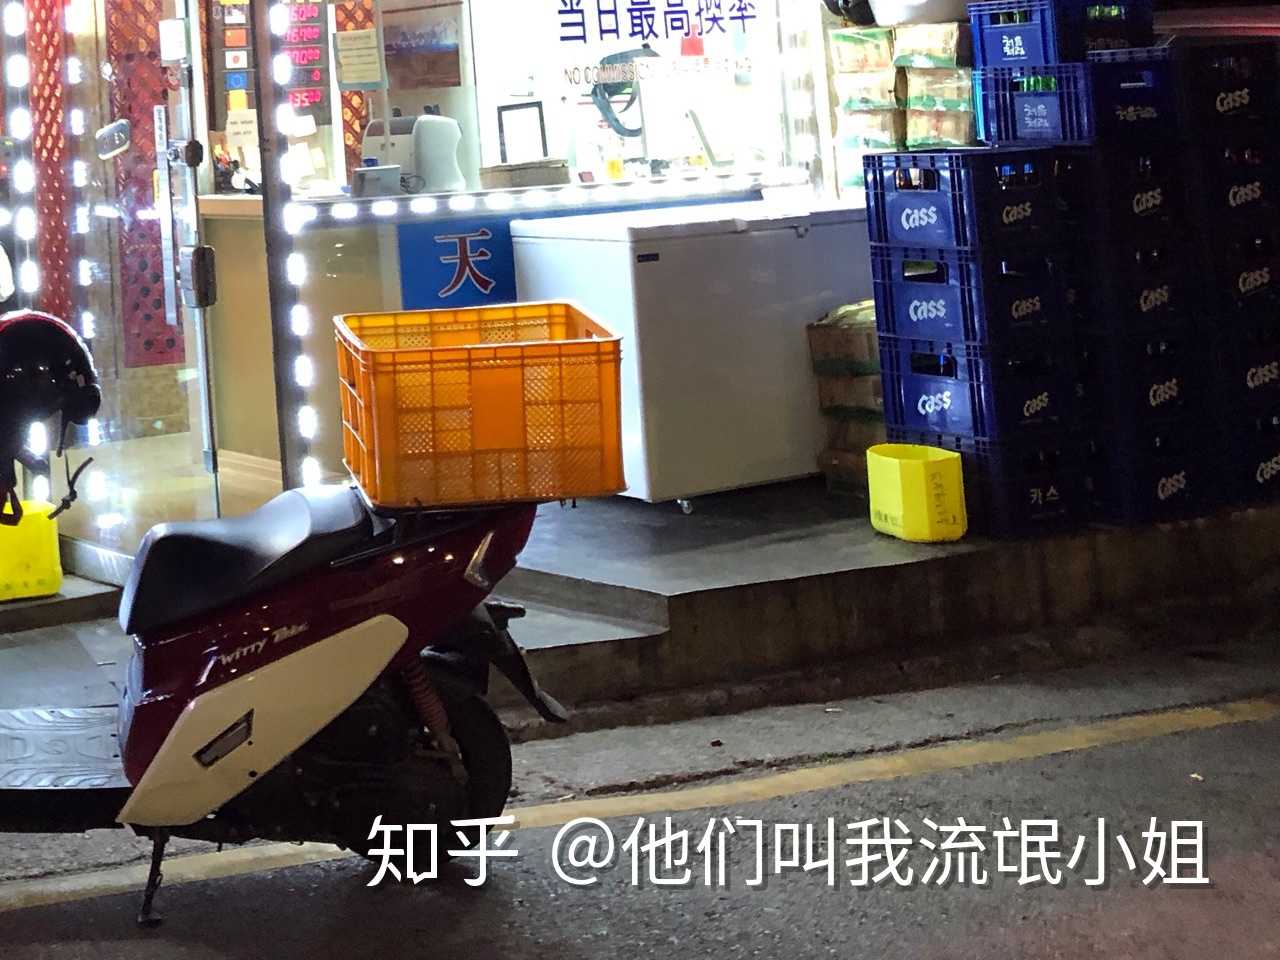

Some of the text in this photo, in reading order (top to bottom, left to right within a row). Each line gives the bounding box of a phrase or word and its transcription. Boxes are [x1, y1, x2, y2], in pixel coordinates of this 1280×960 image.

[1215, 87, 1250, 113] Cass
[1133, 187, 1162, 213] Cass
[1228, 181, 1261, 207] Cass
[901, 205, 938, 230] Cass
[1002, 200, 1033, 225] Cass
[433, 228, 496, 299] 天
[1238, 266, 1271, 292] Cass
[908, 298, 947, 322] Cass
[1011, 295, 1041, 320] Cass
[1139, 285, 1169, 312] Cass
[917, 390, 953, 417] Cass
[1023, 391, 1050, 417] Cass
[1148, 378, 1179, 407] Cass
[1028, 486, 1060, 506] 카스
[1157, 470, 1187, 500] Cass
